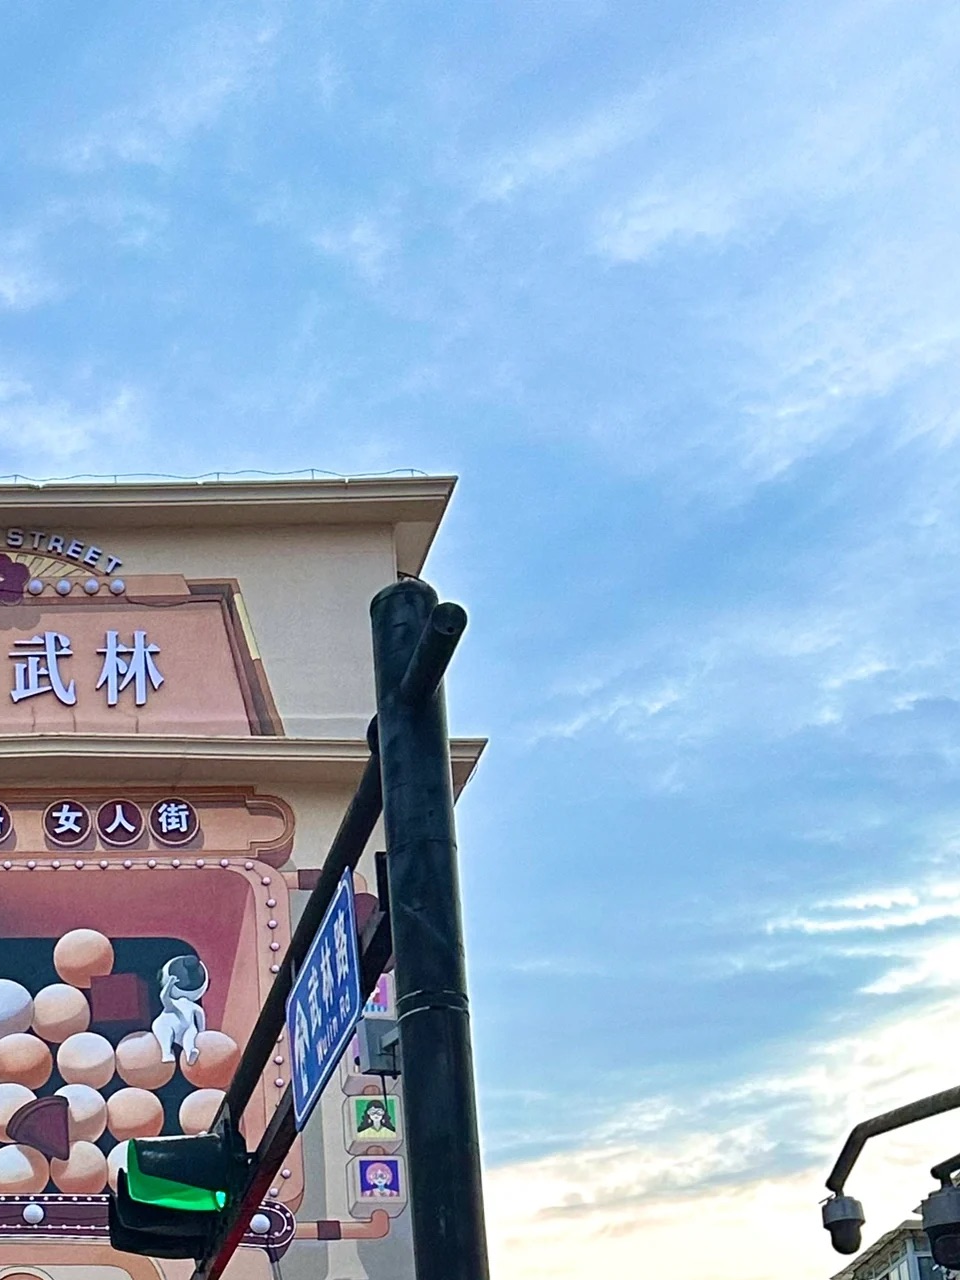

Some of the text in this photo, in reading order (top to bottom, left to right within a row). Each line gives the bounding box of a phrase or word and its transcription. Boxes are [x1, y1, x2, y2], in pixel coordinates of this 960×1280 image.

[6, 528, 123, 576] STREET
[51, 803, 190, 835] 女人街
[308, 909, 350, 1039] 武林路
[315, 986, 352, 1065] Wulin Rd
